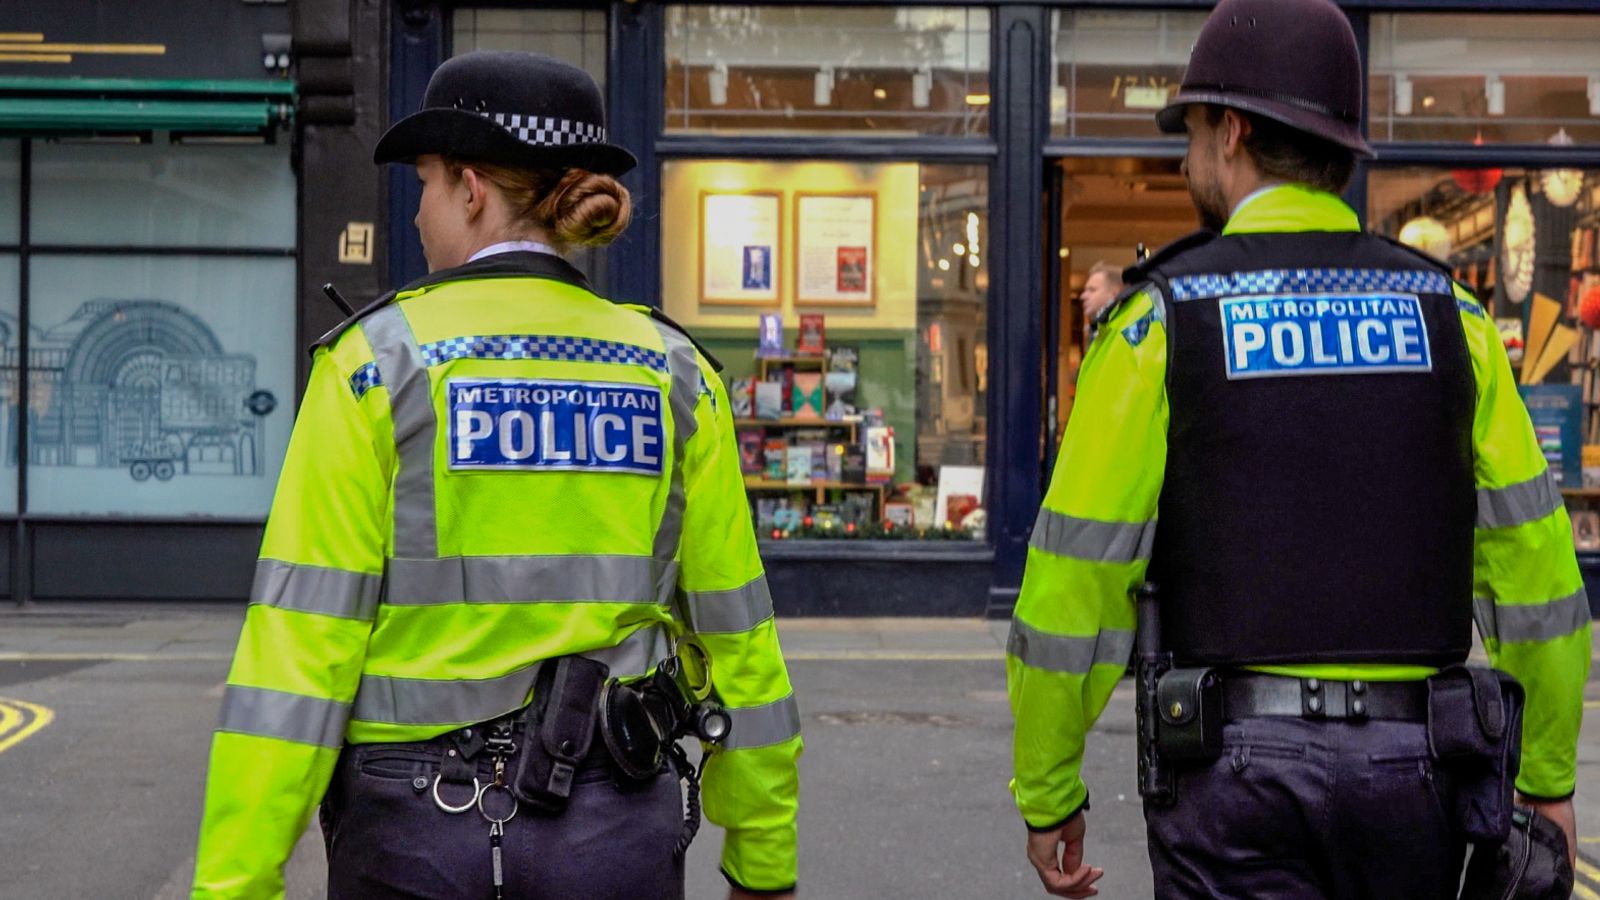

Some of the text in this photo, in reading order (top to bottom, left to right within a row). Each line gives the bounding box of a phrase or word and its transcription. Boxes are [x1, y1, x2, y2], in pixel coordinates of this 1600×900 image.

[1231, 300, 1415, 320] METROPOLITAN
[1233, 318, 1422, 369] POLICE
[457, 387, 656, 410] METROPOLITAN
[456, 409, 658, 465] POLICE
